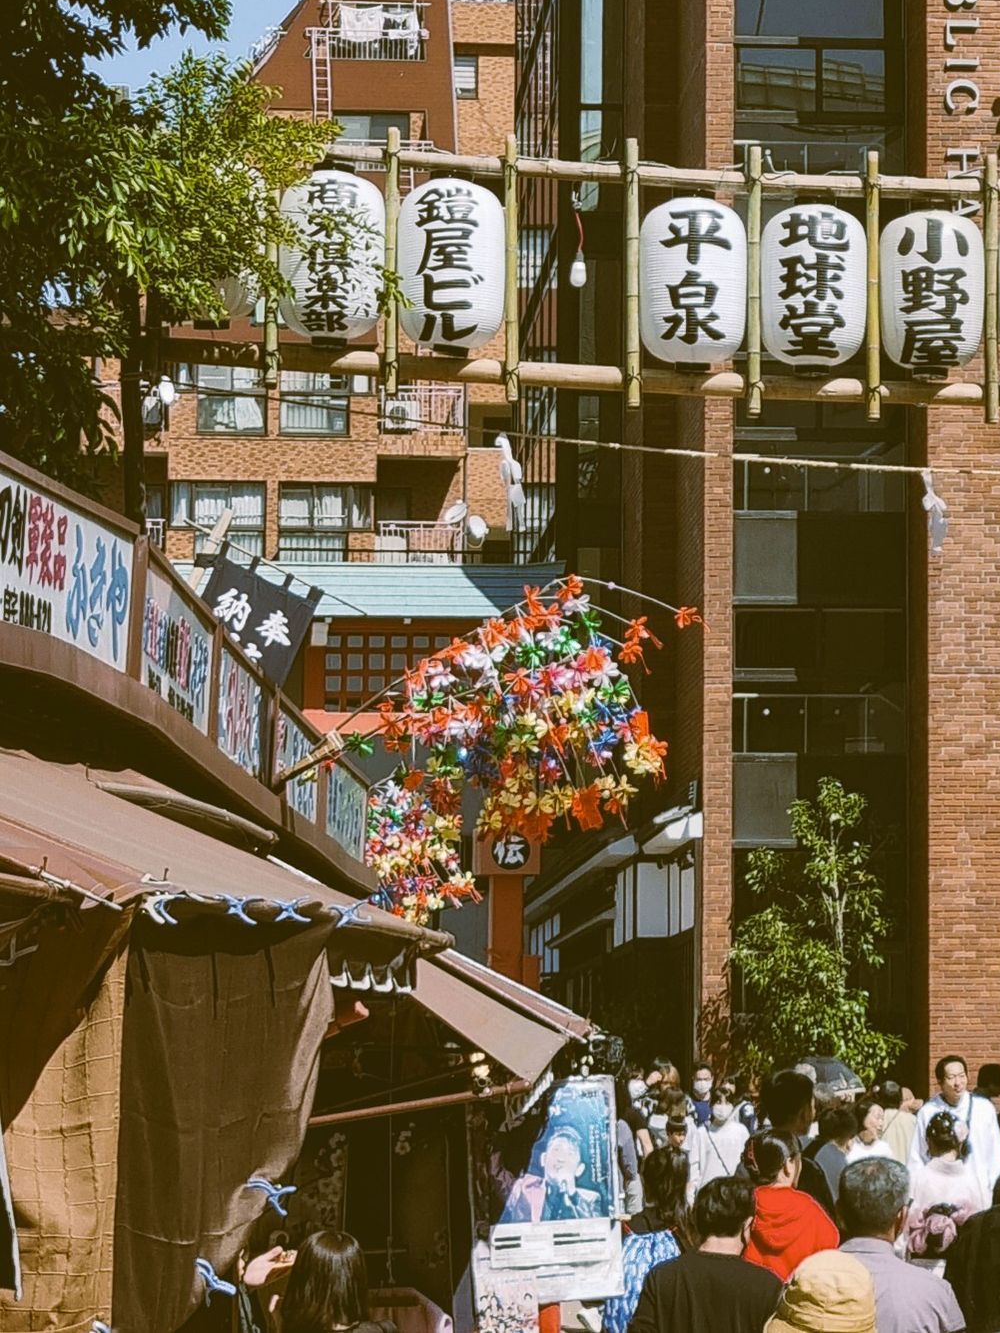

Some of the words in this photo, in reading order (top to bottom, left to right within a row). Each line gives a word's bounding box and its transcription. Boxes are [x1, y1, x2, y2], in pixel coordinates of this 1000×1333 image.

[415, 187, 484, 342] 鎧屋ビル
[659, 209, 732, 345] 平泉
[778, 211, 850, 358] 地球堂
[898, 218, 969, 366] 小野屋
